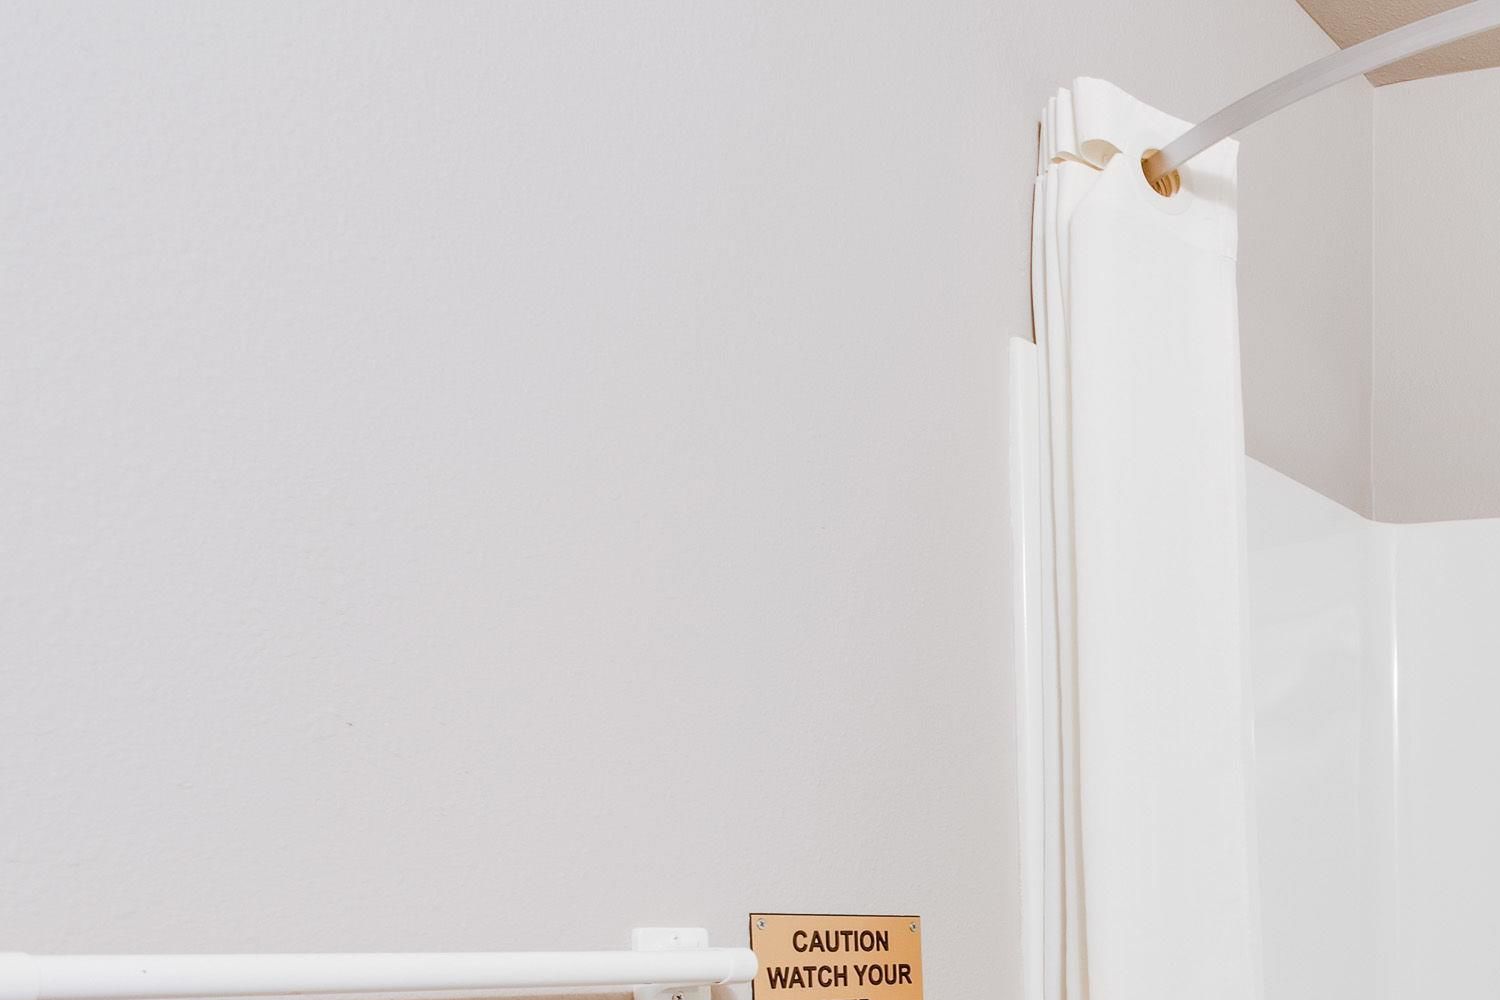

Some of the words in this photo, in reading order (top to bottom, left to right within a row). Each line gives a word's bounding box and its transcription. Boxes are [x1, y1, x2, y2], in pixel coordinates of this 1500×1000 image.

[793, 930, 889, 953] CAUTION
[767, 965, 848, 989] WATCH
[854, 964, 913, 986] YOUR
